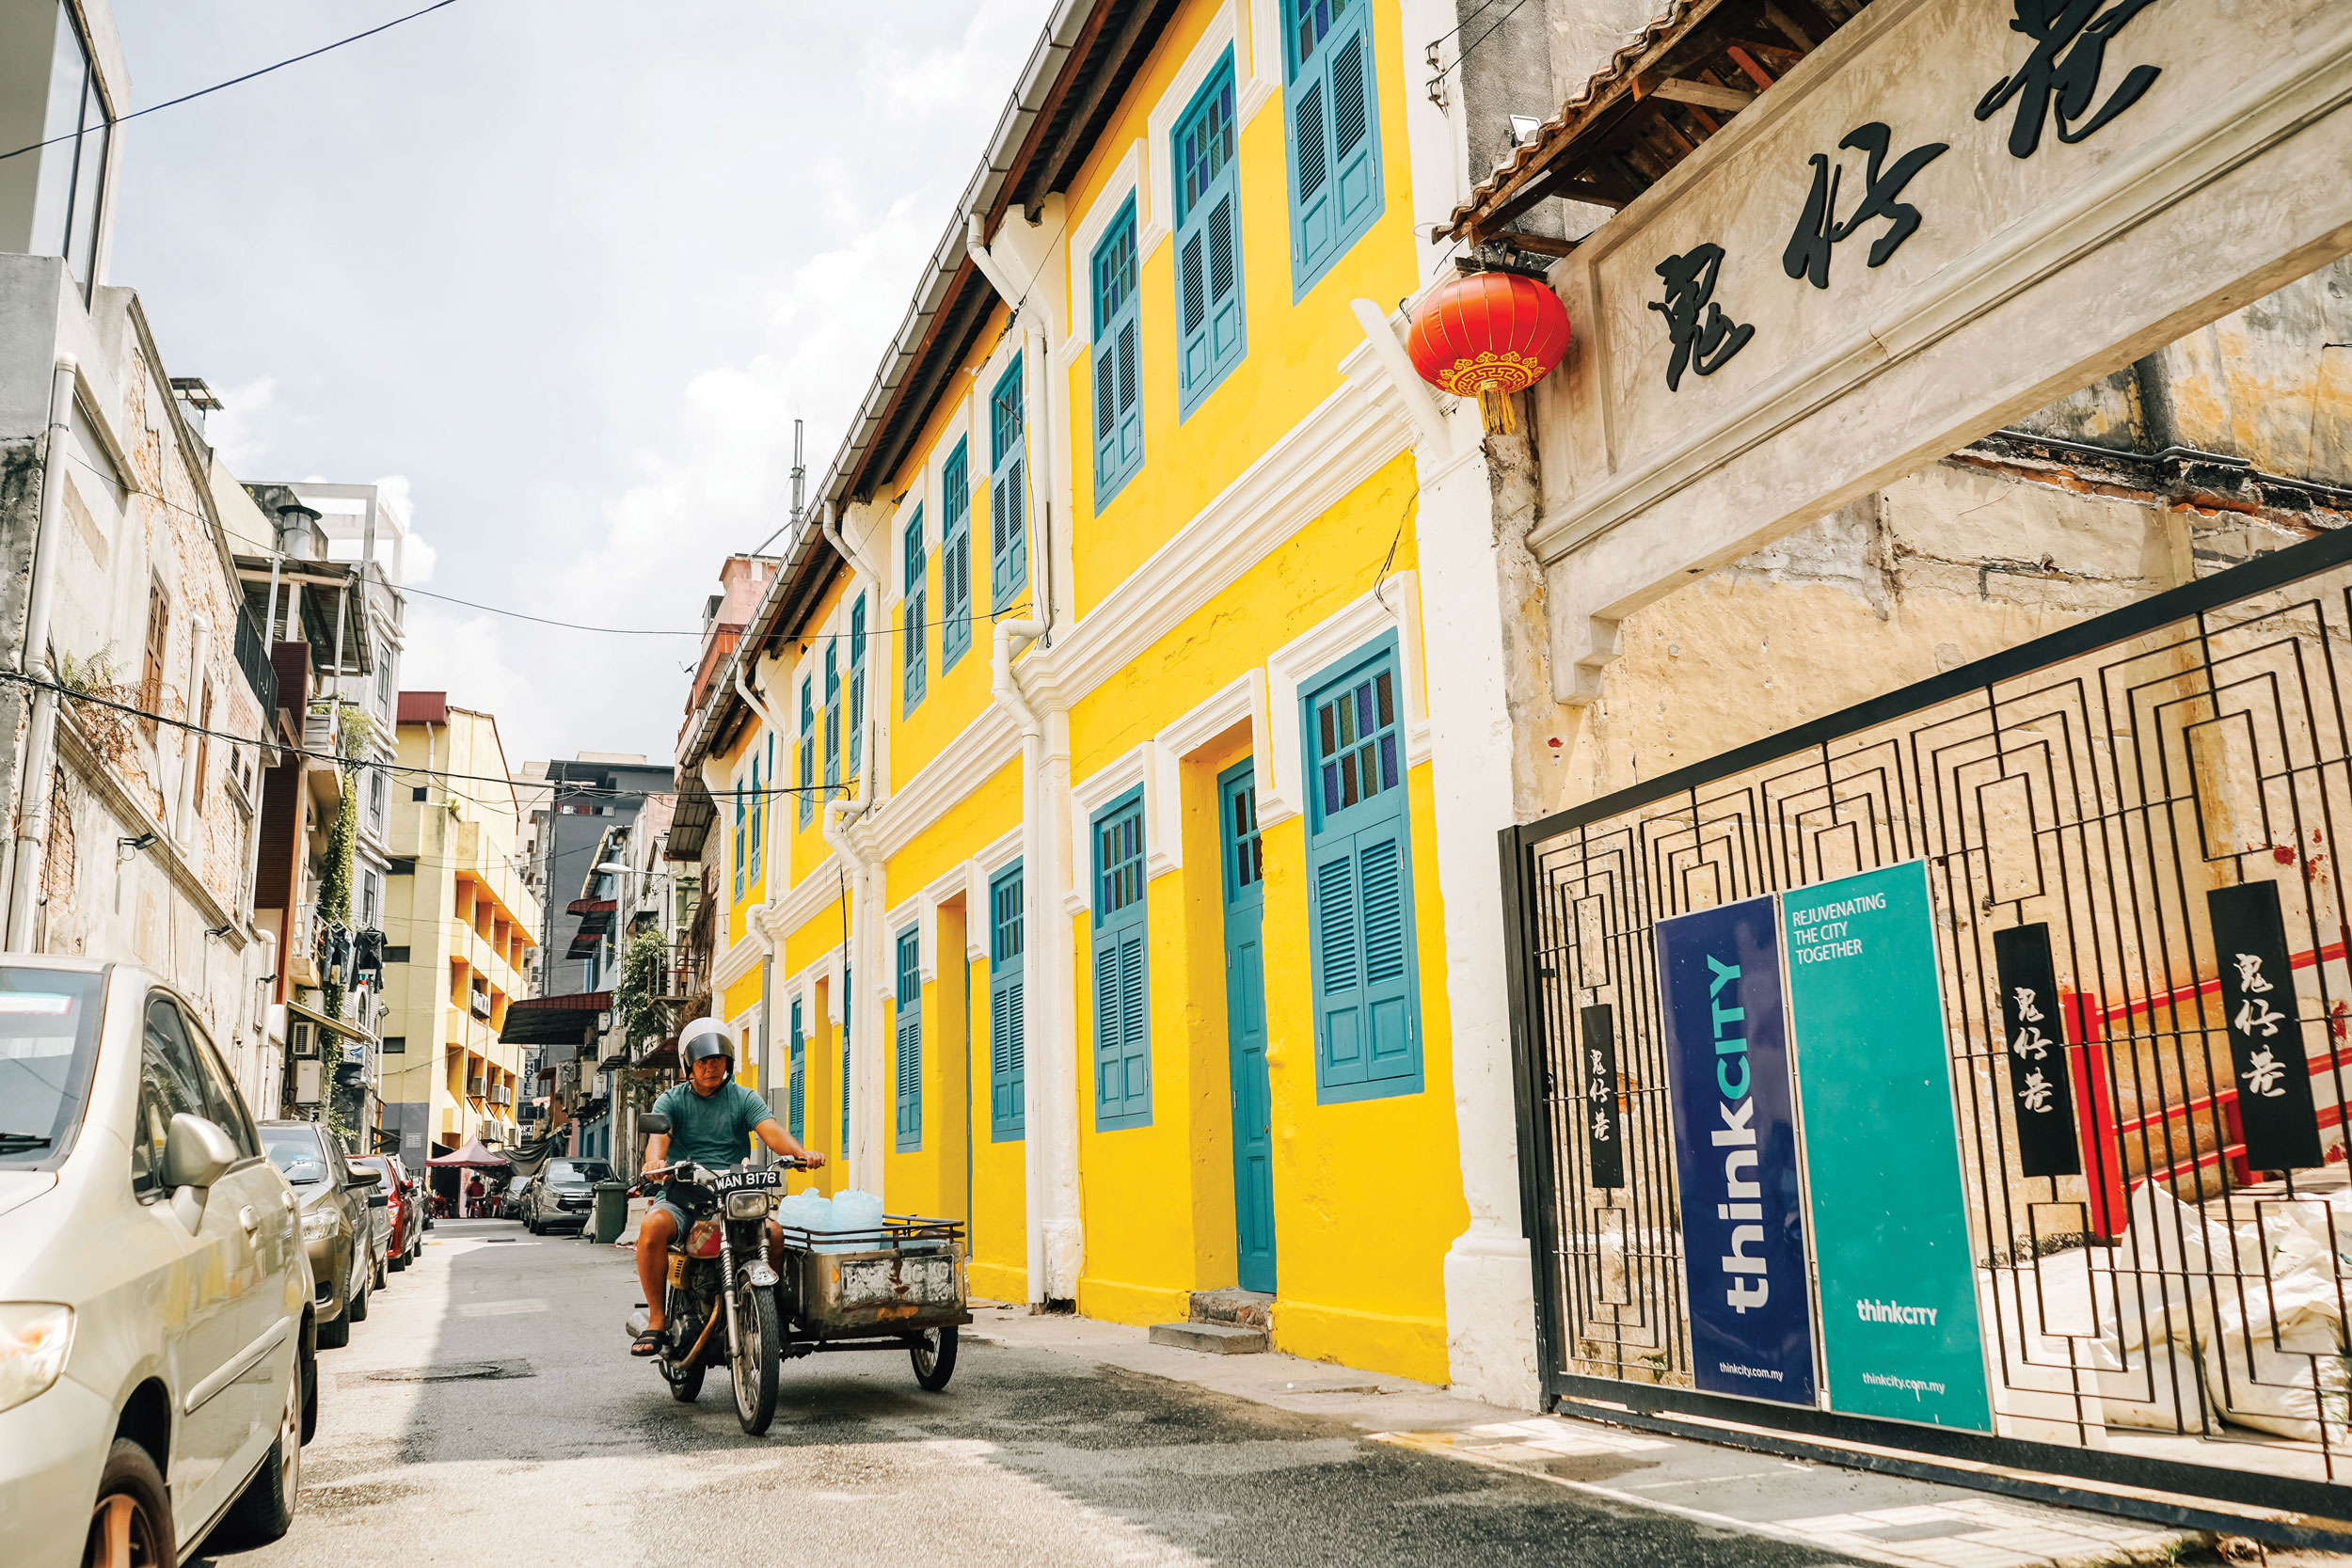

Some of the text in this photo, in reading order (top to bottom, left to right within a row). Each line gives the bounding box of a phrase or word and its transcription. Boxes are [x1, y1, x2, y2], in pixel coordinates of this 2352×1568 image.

[1792, 893, 1886, 927] REJUVENATING
[1793, 921, 1848, 945] THE CITY
[1795, 939, 1863, 965] TOGETHER
[523, 1063, 533, 1096] HOTEL
[1706, 954, 1770, 1315] thinkCITY
[715, 1172, 776, 1191] WAN 8176
[1856, 1298, 1938, 1326] thinkCITY
[1719, 1362, 1784, 1383] thinkcity.com.my
[1862, 1372, 1946, 1395] thinkcity.com.my
